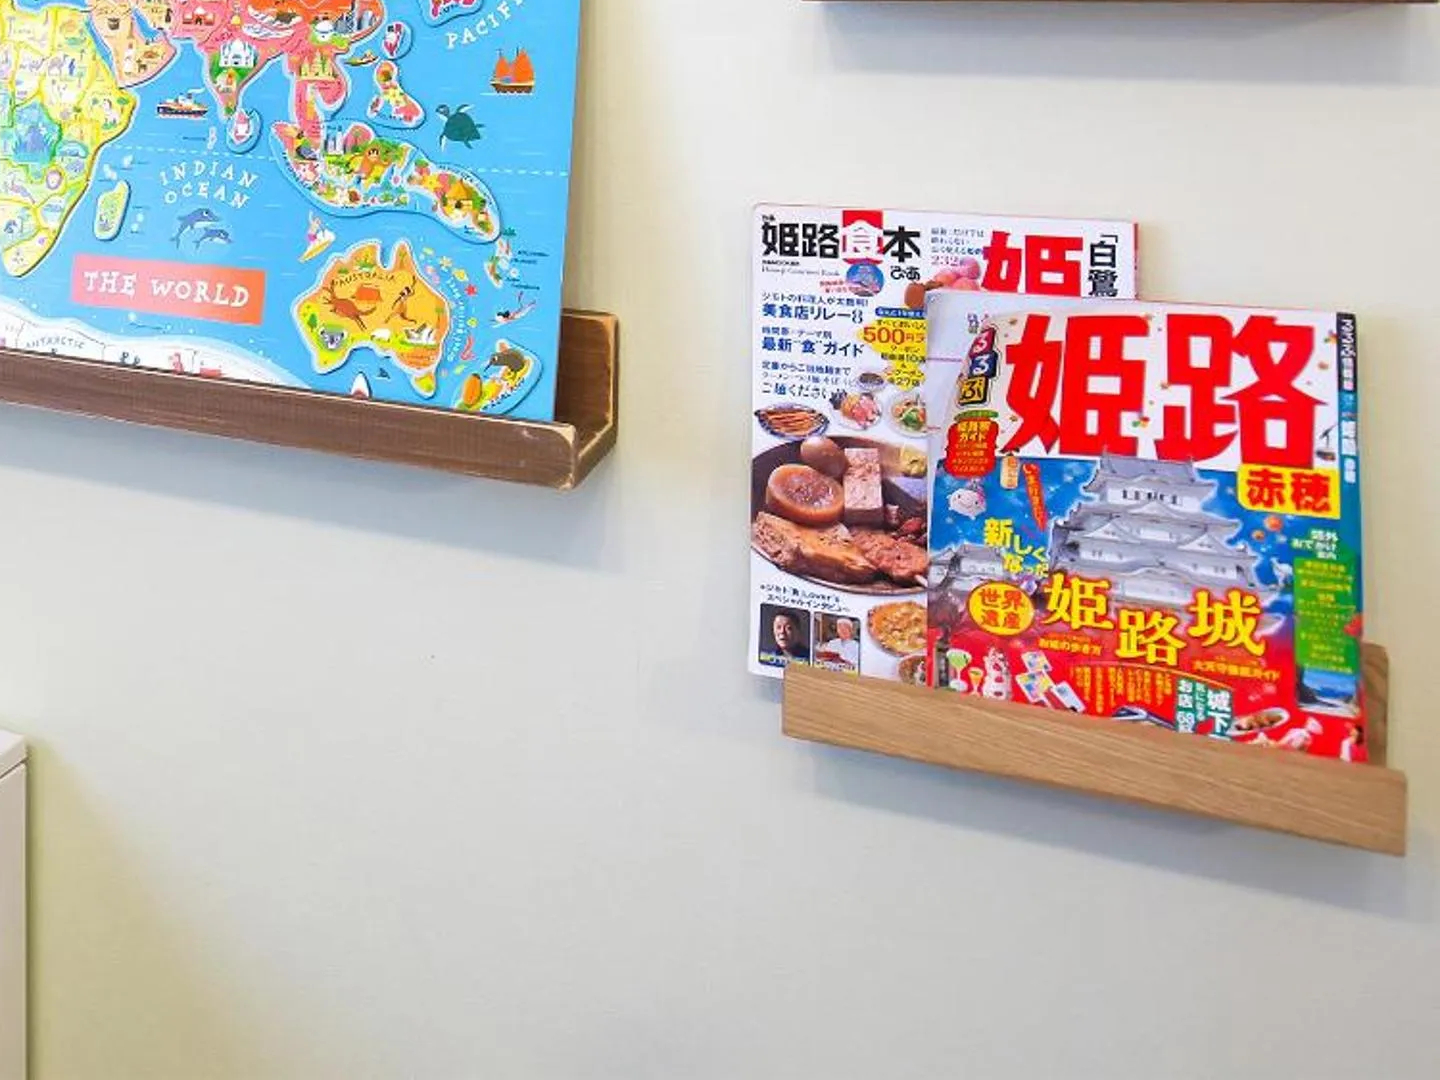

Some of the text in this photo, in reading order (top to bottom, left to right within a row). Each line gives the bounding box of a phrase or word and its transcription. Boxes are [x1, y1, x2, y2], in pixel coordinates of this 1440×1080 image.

[160, 160, 259, 188] INDIAN
[164, 181, 250, 208] OCEAN
[84, 271, 250, 308] THE WORLD
[890, 265, 921, 280] ぴあ
[958, 328, 998, 405] るるぶ
[1005, 313, 1329, 469] 姫路
[1245, 469, 1332, 513] 赤穂
[979, 588, 1026, 610] 世界
[1044, 573, 1266, 667] 姫路城
